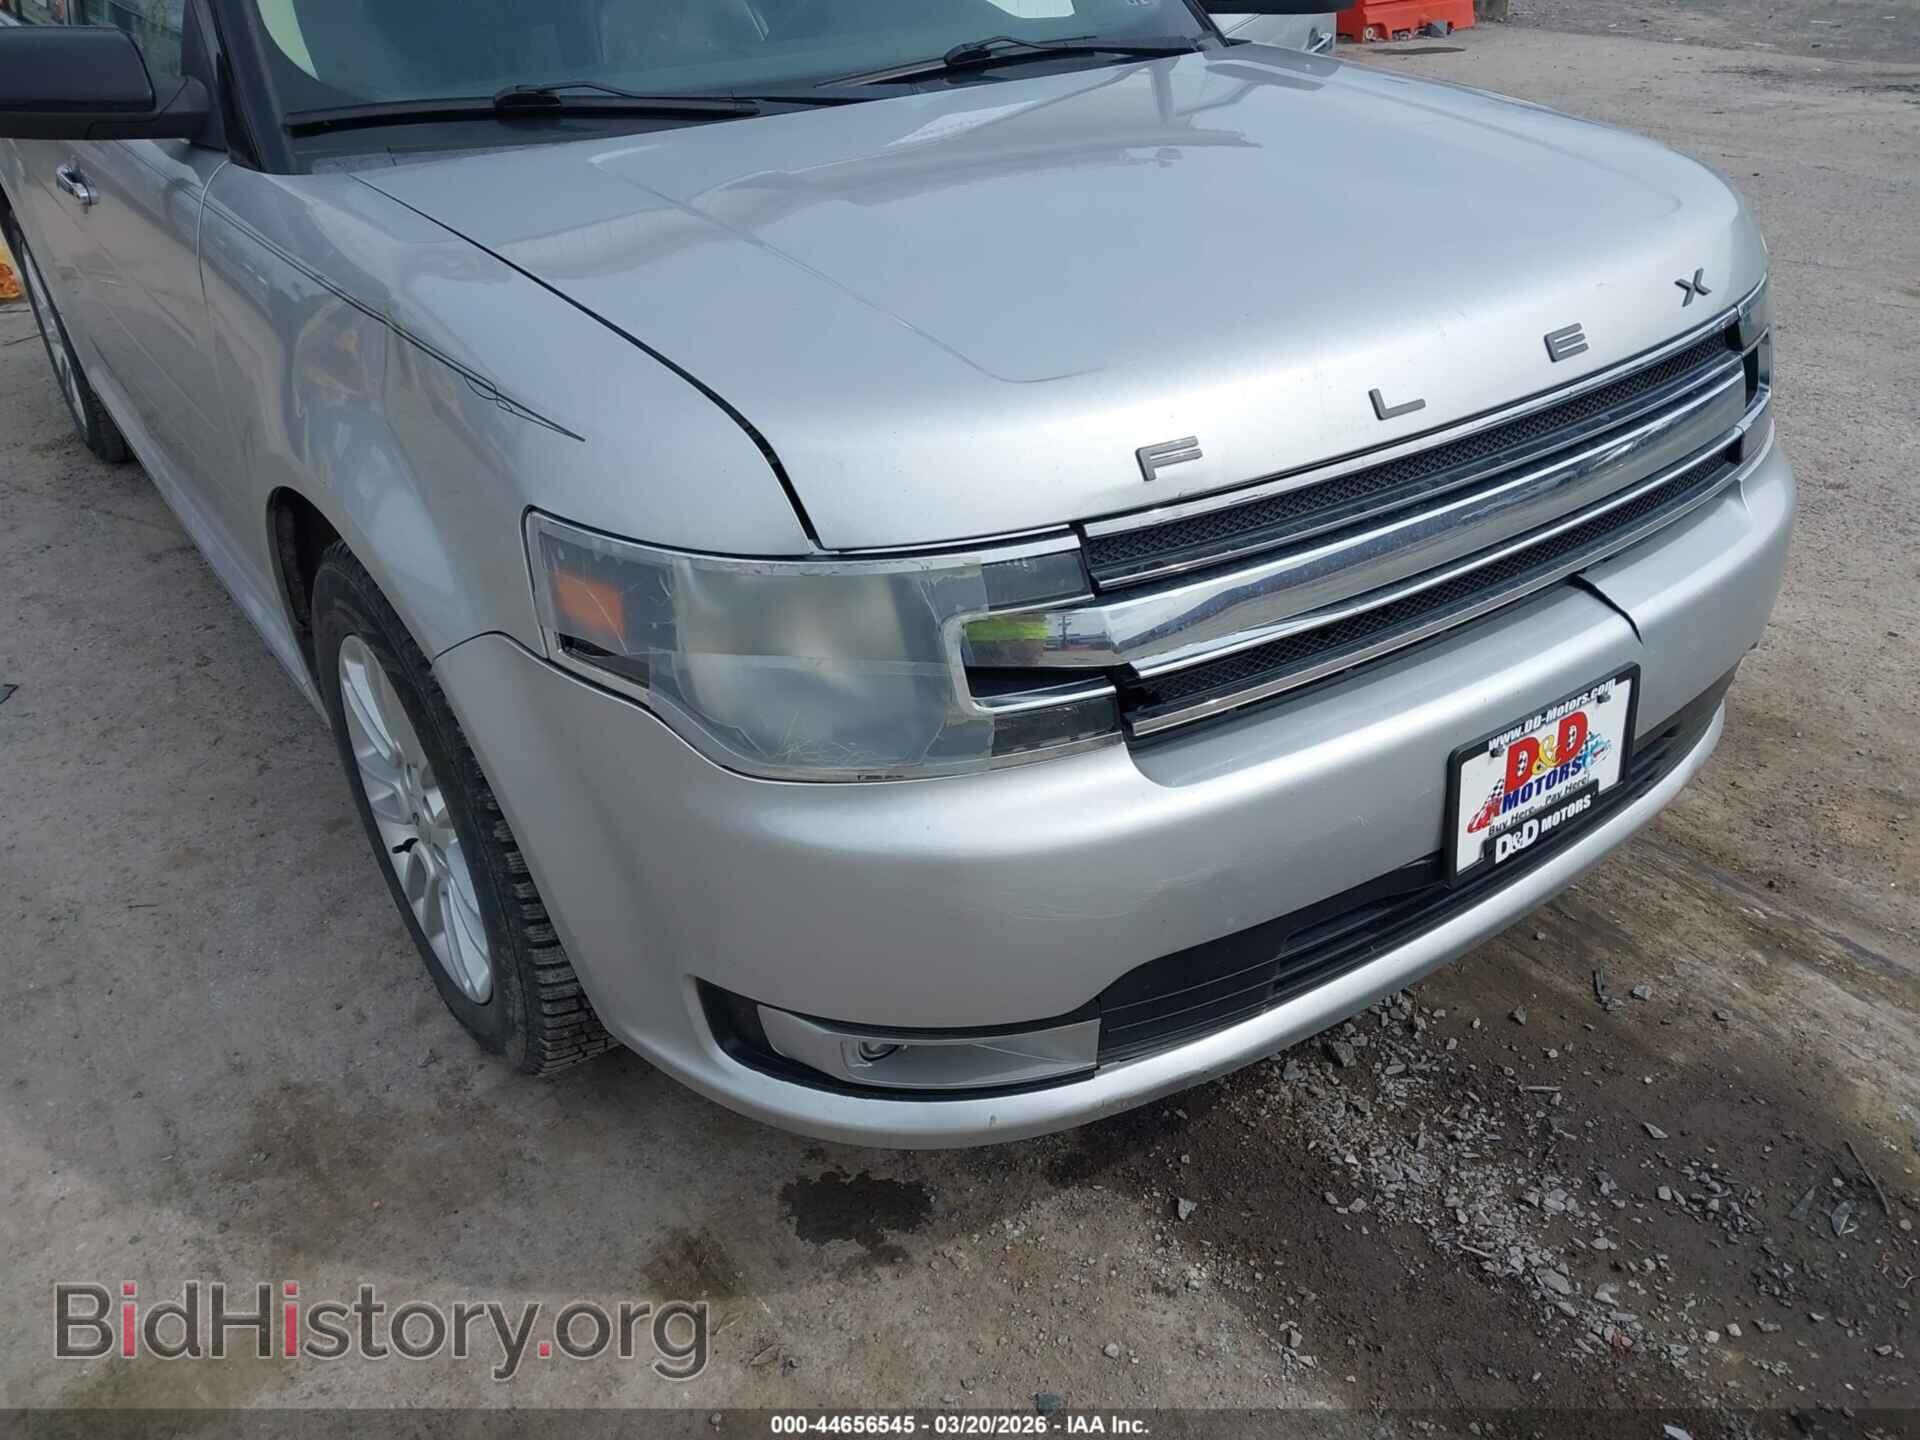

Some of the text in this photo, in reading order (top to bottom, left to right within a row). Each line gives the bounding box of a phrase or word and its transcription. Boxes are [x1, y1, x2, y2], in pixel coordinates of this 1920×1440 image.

[1135, 268, 1711, 482] FLEX
[1489, 679, 1616, 750] www.DD-Motors.com
[1502, 757, 1582, 814] MOTORS
[1504, 711, 1588, 793] D&D
[1495, 794, 1592, 864] D&D MOTORS
